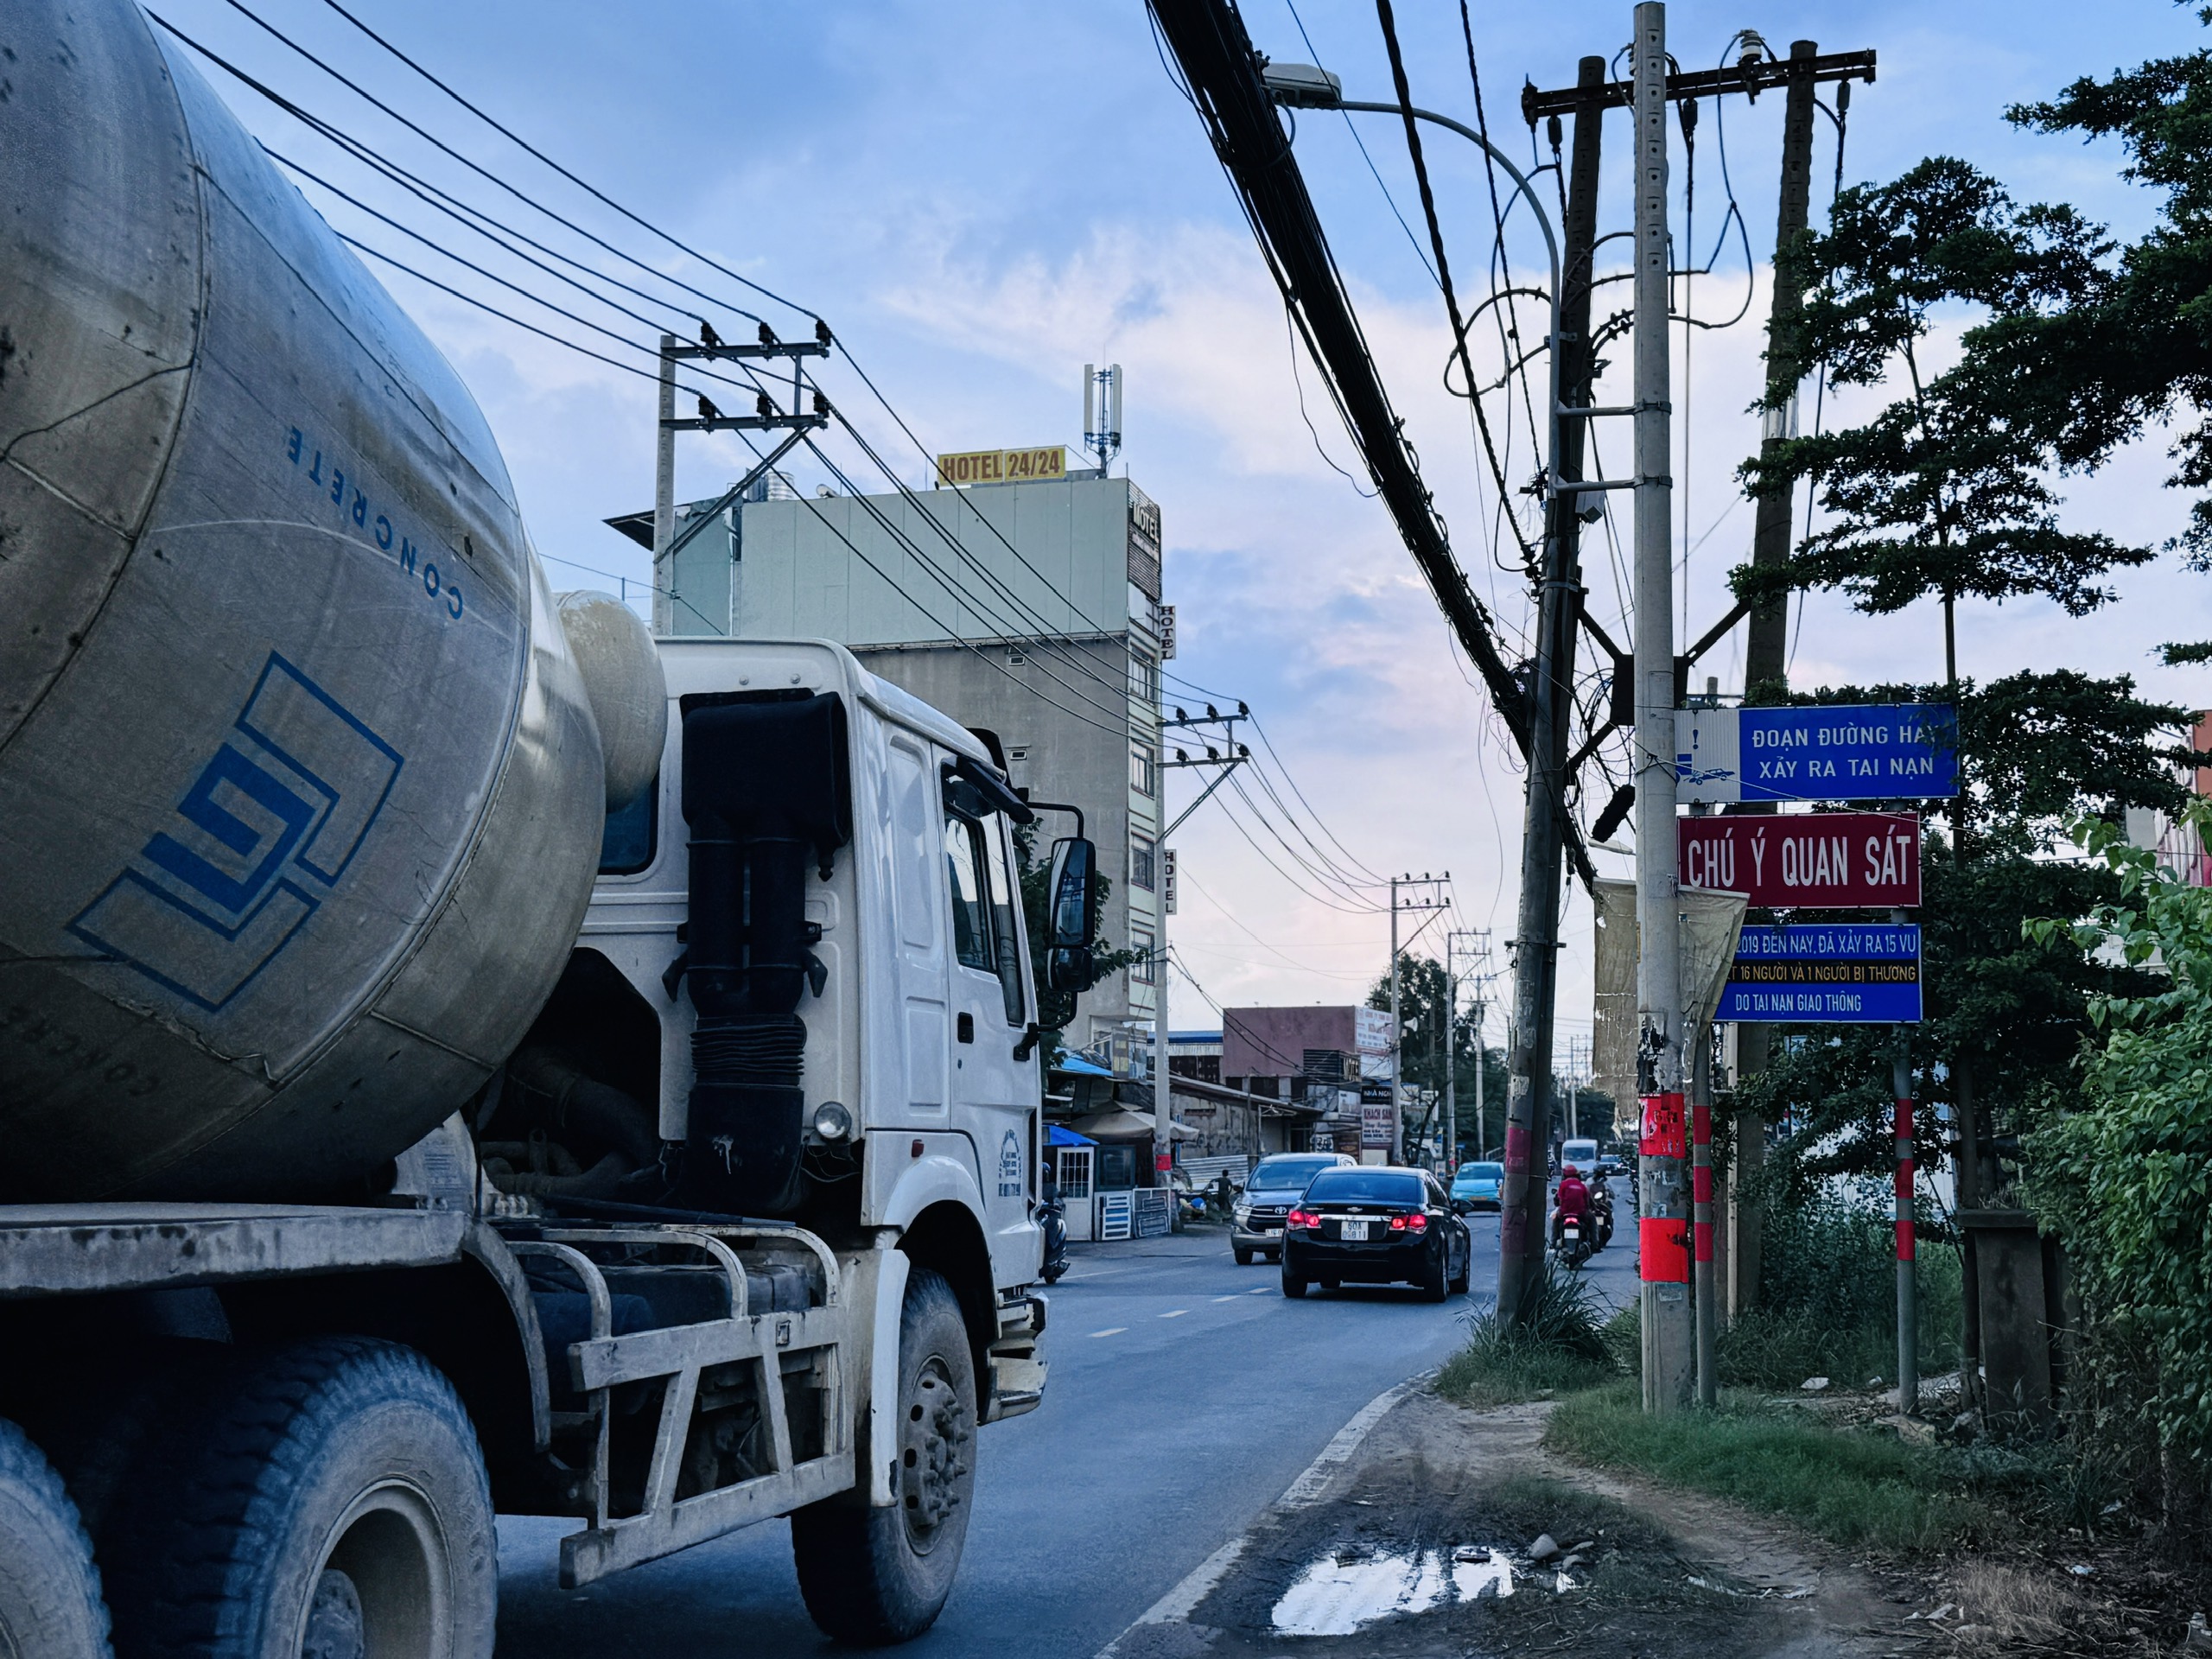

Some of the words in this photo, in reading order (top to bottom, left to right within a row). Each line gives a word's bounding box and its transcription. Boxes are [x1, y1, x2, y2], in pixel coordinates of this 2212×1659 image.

[944, 454, 1002, 481] HOTEL
[1008, 450, 1060, 477] 24/24
[288, 424, 463, 620] CONCRETE
[1160, 607, 1174, 659] HOTEL
[1752, 728, 1808, 751] ĐOẠN
[1817, 722, 1888, 746] ĐƯỜNG
[1759, 756, 1797, 779] XẢY
[1808, 760, 1836, 778] RA
[1847, 758, 1878, 777] TAI
[1890, 757, 1933, 779] NẠN
[1688, 827, 1735, 887] CHÚ
[1751, 826, 1766, 887] Ý
[1782, 836, 1848, 887] QUAN
[1865, 824, 1910, 887] SÁT
[1164, 851, 1174, 913] HOTEL
[1818, 931, 1835, 953] ĐÃ
[1838, 929, 1861, 953] XẢY
[1866, 935, 1884, 953] RA
[1885, 935, 1897, 952] 15
[1899, 934, 1916, 956] VỤ
[1740, 966, 1751, 981] 16
[1753, 961, 1787, 981] NGƯỜI
[1790, 961, 1805, 981] VÀ
[1815, 962, 1849, 981] NGƯỜI
[1853, 966, 1865, 983] BỊ
[1868, 965, 1916, 981] THƯƠNG
[1735, 994, 1750, 1011] DO
[1752, 994, 1769, 1011] TAI
[1771, 994, 1794, 1015] NẠN
[1797, 994, 1822, 1011] GIAO
[1825, 990, 1861, 1012] THÔNG
